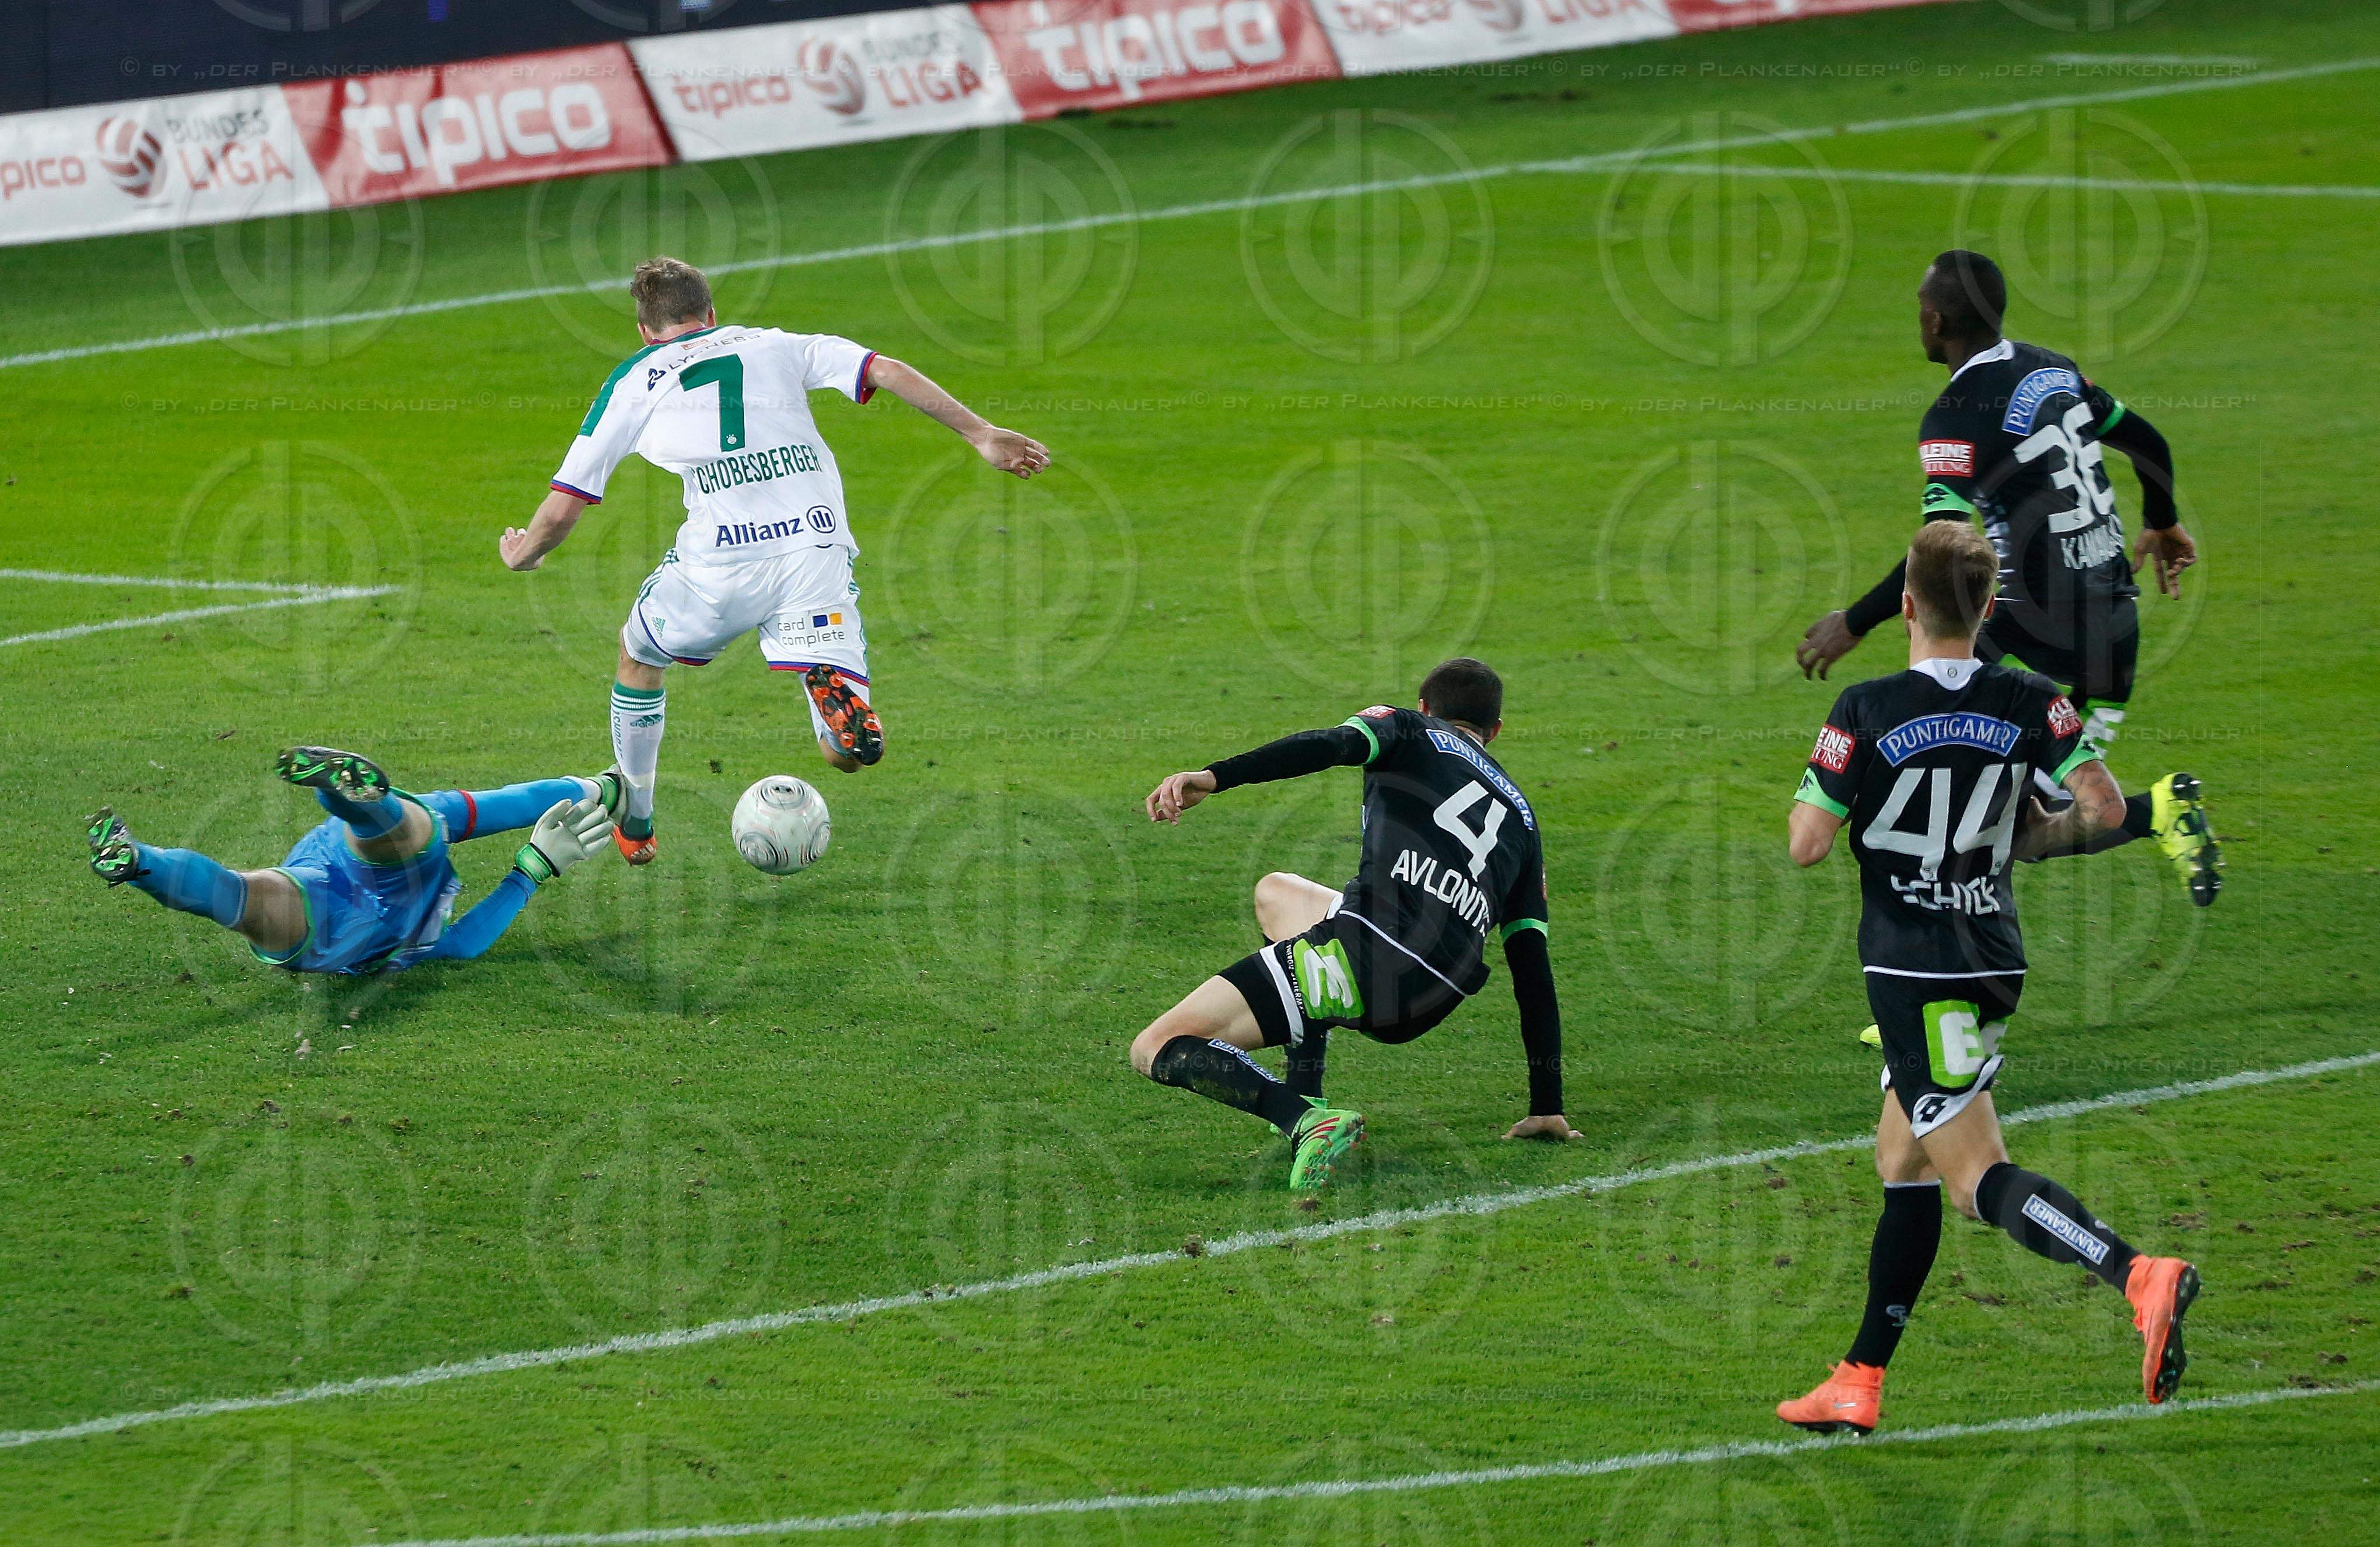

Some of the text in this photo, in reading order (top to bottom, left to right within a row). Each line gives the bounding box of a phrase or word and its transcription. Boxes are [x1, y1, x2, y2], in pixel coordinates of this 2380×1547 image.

[1027, 0, 1285, 99] tipico
[673, 75, 792, 118] tipico
[880, 60, 986, 107] LIGA
[341, 80, 611, 185] tipico
[178, 141, 292, 191] LIGA
[678, 352, 745, 453] 7
[691, 444, 823, 495] CHOBESBERGER
[715, 518, 804, 547] Allianz
[778, 618, 804, 631] card
[782, 630, 845, 648] complete
[1433, 780, 1508, 882] 4
[1862, 761, 2028, 881] 44
[2029, 1199, 2103, 1259] PUNTIGAMER
